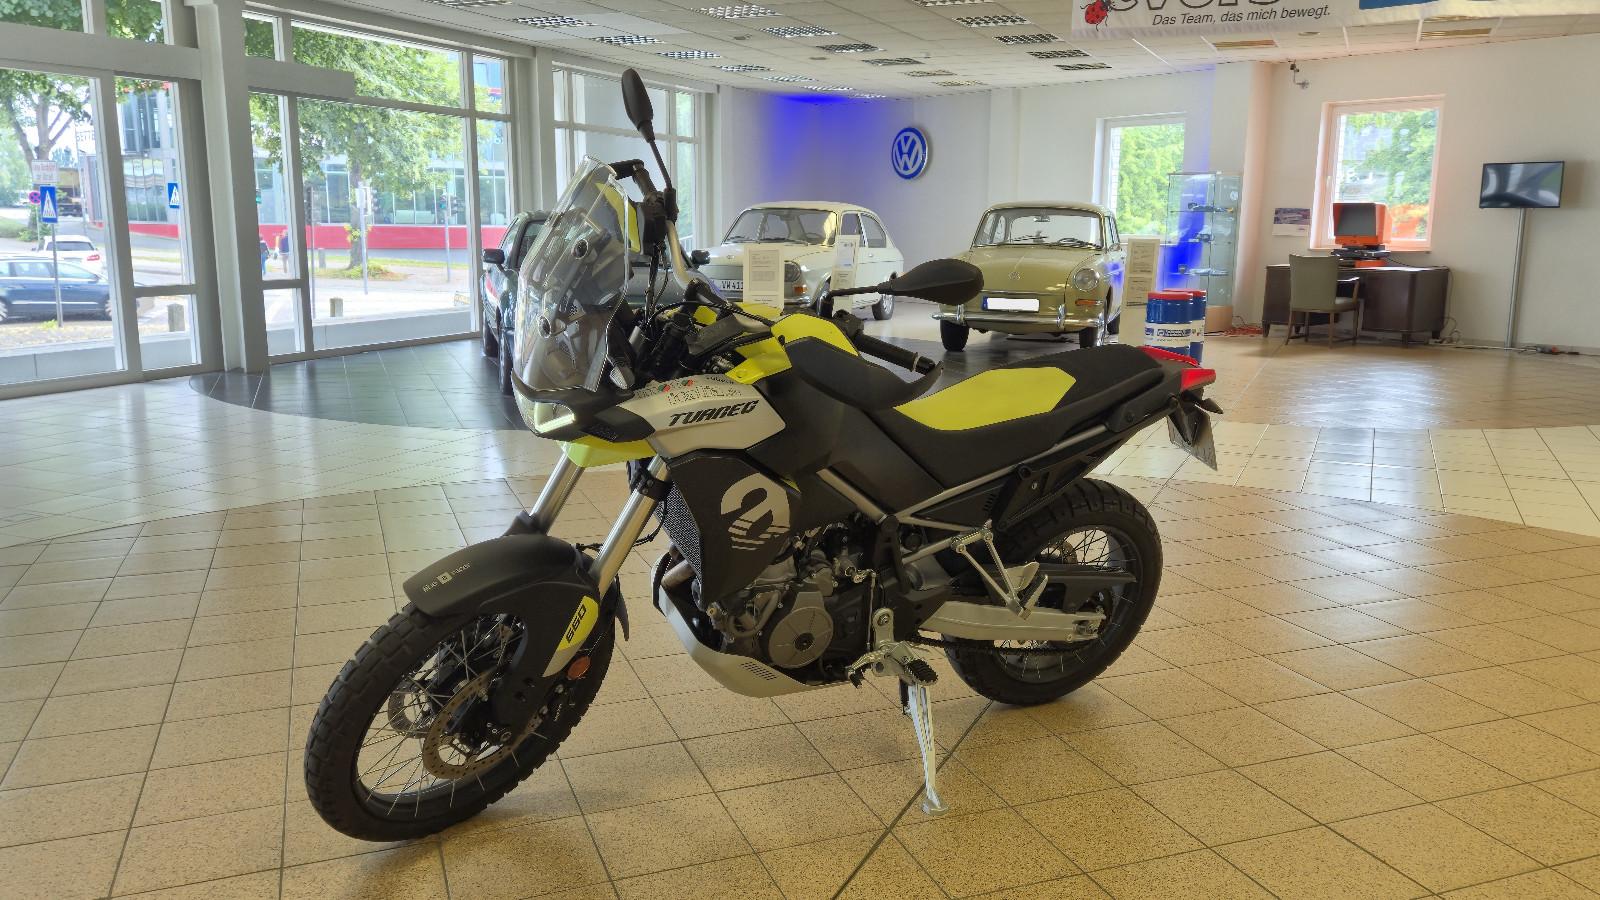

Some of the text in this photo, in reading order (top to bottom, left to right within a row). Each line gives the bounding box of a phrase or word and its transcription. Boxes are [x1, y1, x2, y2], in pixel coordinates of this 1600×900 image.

[1152, 14, 1177, 26] Das
[1180, 12, 1216, 25] Team,
[1220, 11, 1243, 22] das
[1246, 8, 1277, 21] mich
[1280, 4, 1331, 19] bewegt.
[668, 399, 760, 427] TUAREG
[565, 604, 587, 643] 660
